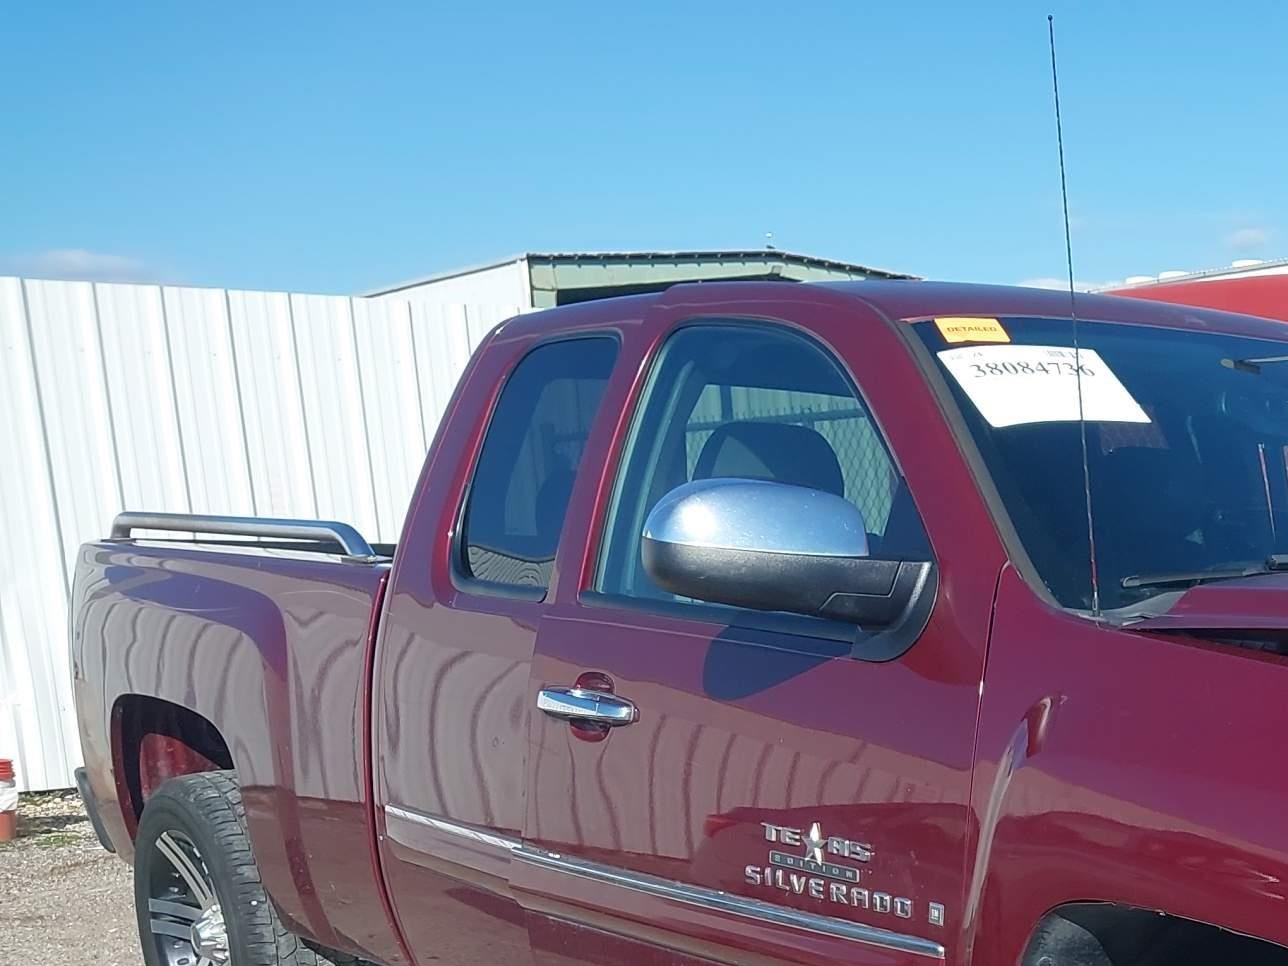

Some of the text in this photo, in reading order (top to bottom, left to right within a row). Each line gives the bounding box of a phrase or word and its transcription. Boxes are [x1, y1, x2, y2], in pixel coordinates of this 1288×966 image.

[970, 361, 1096, 378] 38084736
[774, 853, 854, 879] EDITION
[744, 864, 912, 919] SILVERADO
